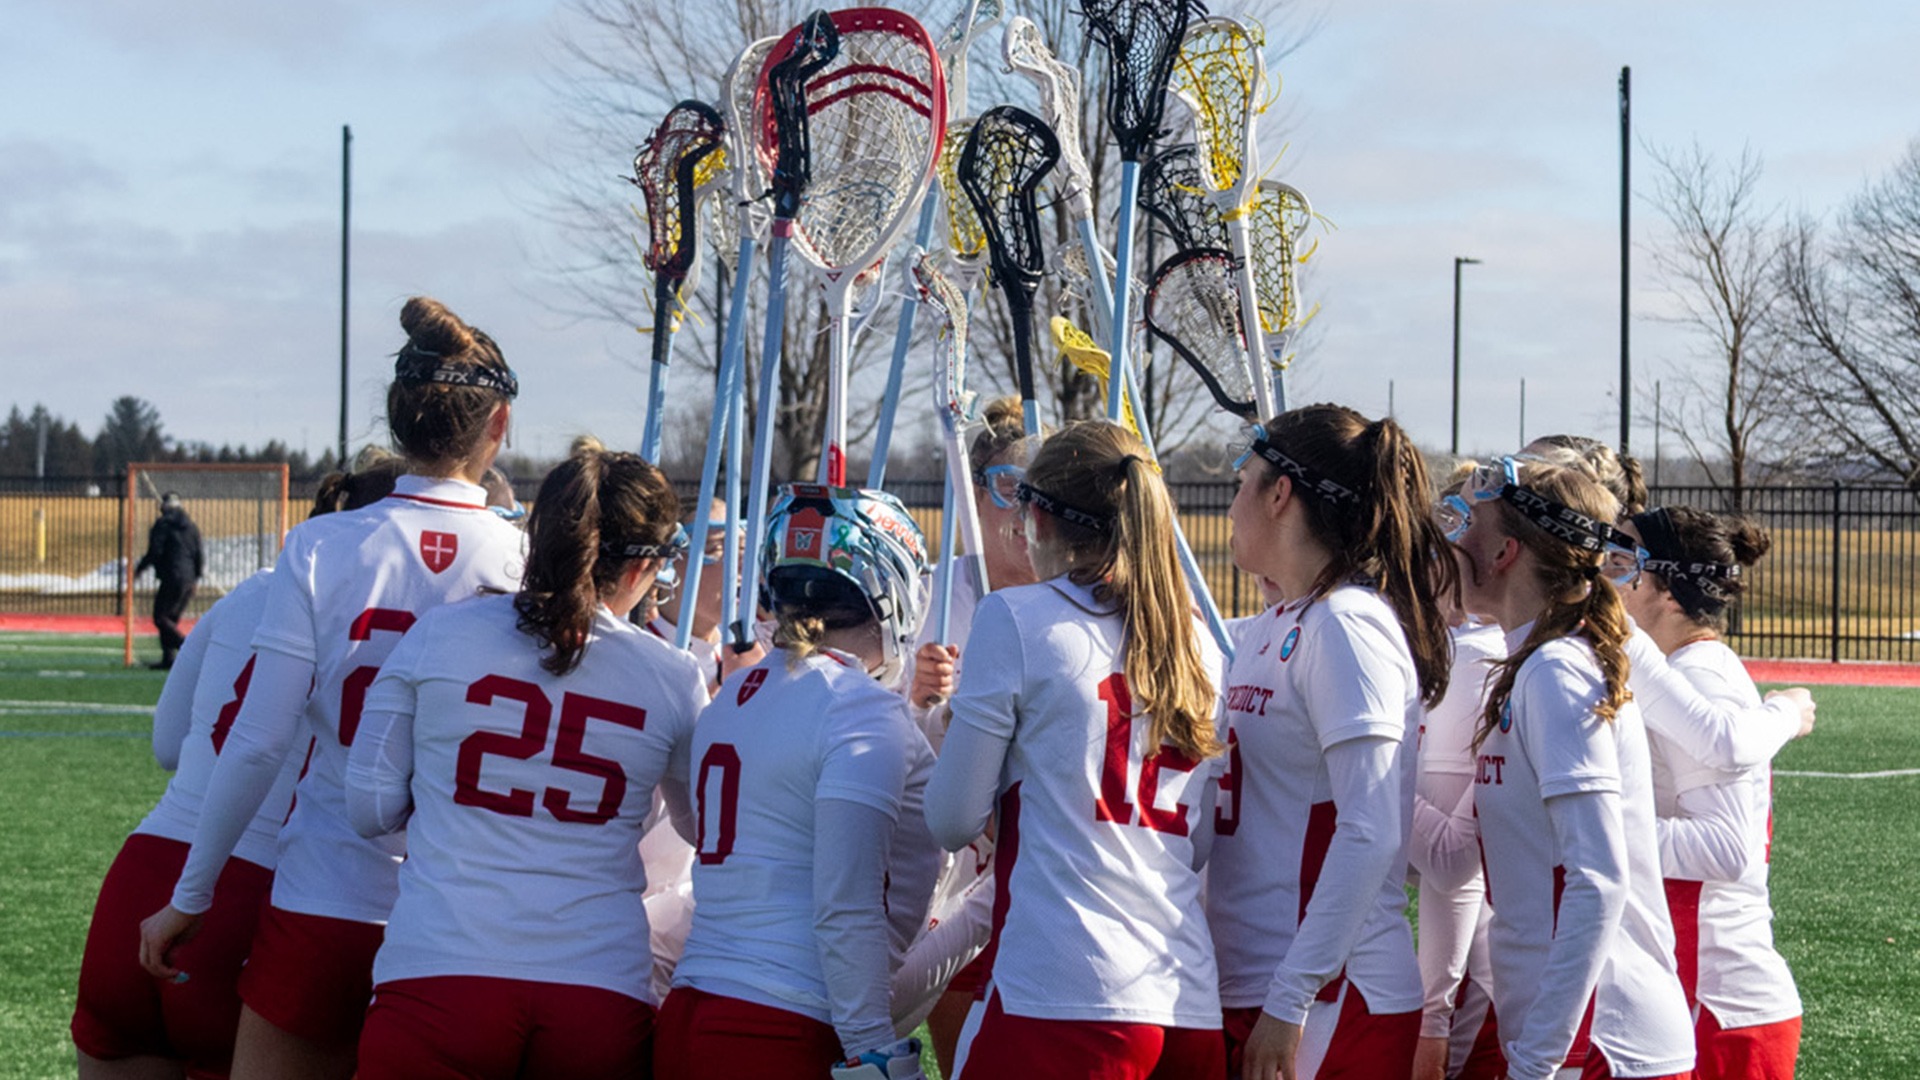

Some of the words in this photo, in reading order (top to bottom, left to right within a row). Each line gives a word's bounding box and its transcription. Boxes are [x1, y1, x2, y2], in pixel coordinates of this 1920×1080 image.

[433, 369, 469, 384] STX
[1264, 447, 1308, 478] STX
[1317, 478, 1353, 499] ST
[1513, 488, 1551, 512] STX
[1559, 507, 1595, 531] STX
[1537, 514, 1576, 541] STX
[624, 544, 661, 556] STX
[1645, 559, 1681, 572] STX
[453, 673, 647, 825] 25
[696, 742, 742, 866] 0
